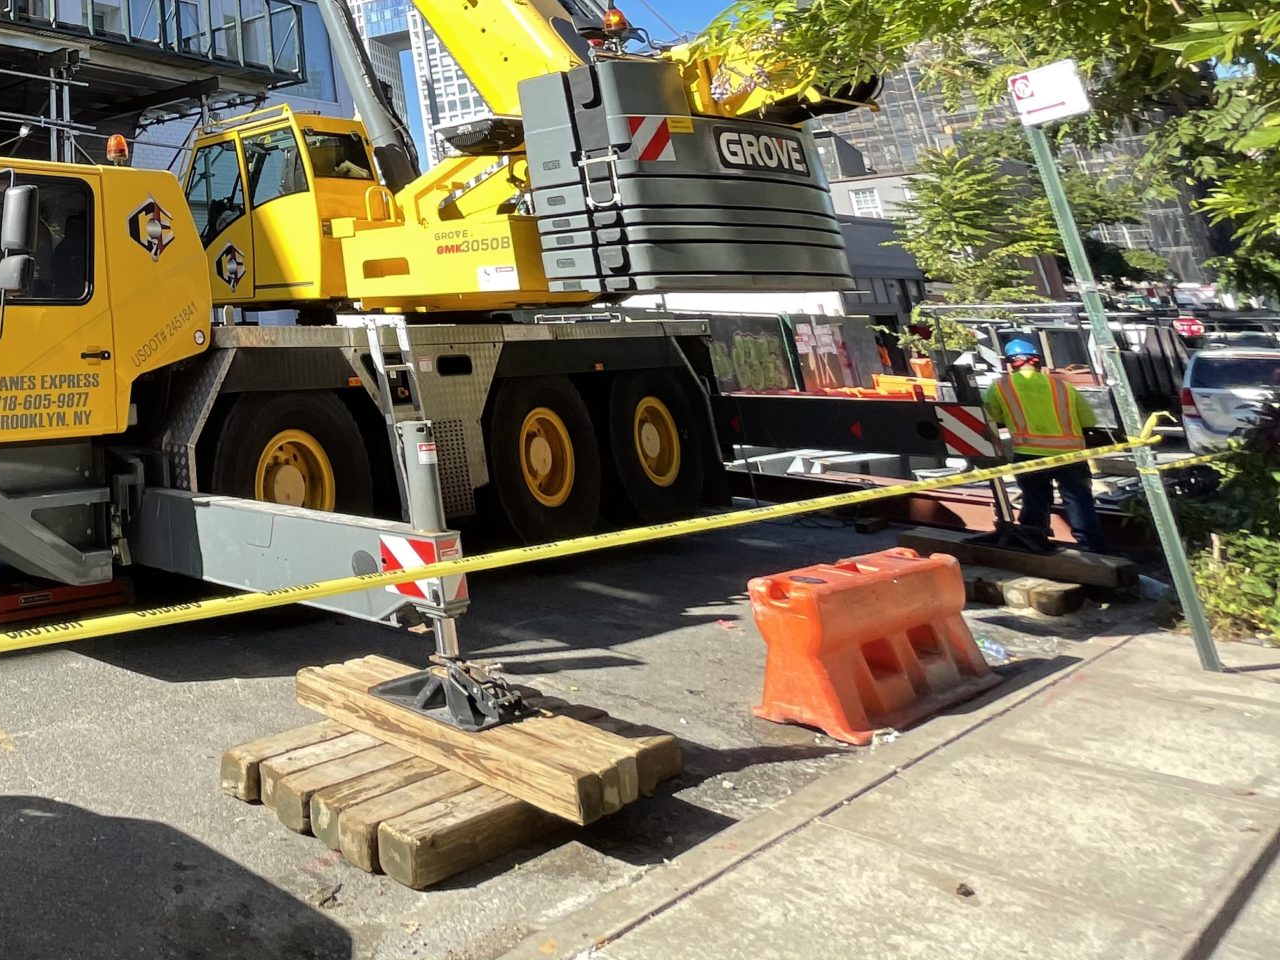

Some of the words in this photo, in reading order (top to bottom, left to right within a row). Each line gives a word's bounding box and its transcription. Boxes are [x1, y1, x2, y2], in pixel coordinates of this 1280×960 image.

[720, 131, 805, 172] GROVE
[434, 230, 469, 241] GROVE
[131, 328, 168, 368] USDOT#
[165, 301, 199, 337] 2451841
[40, 373, 100, 390] EXPRESS
[73, 410, 93, 425] NY
